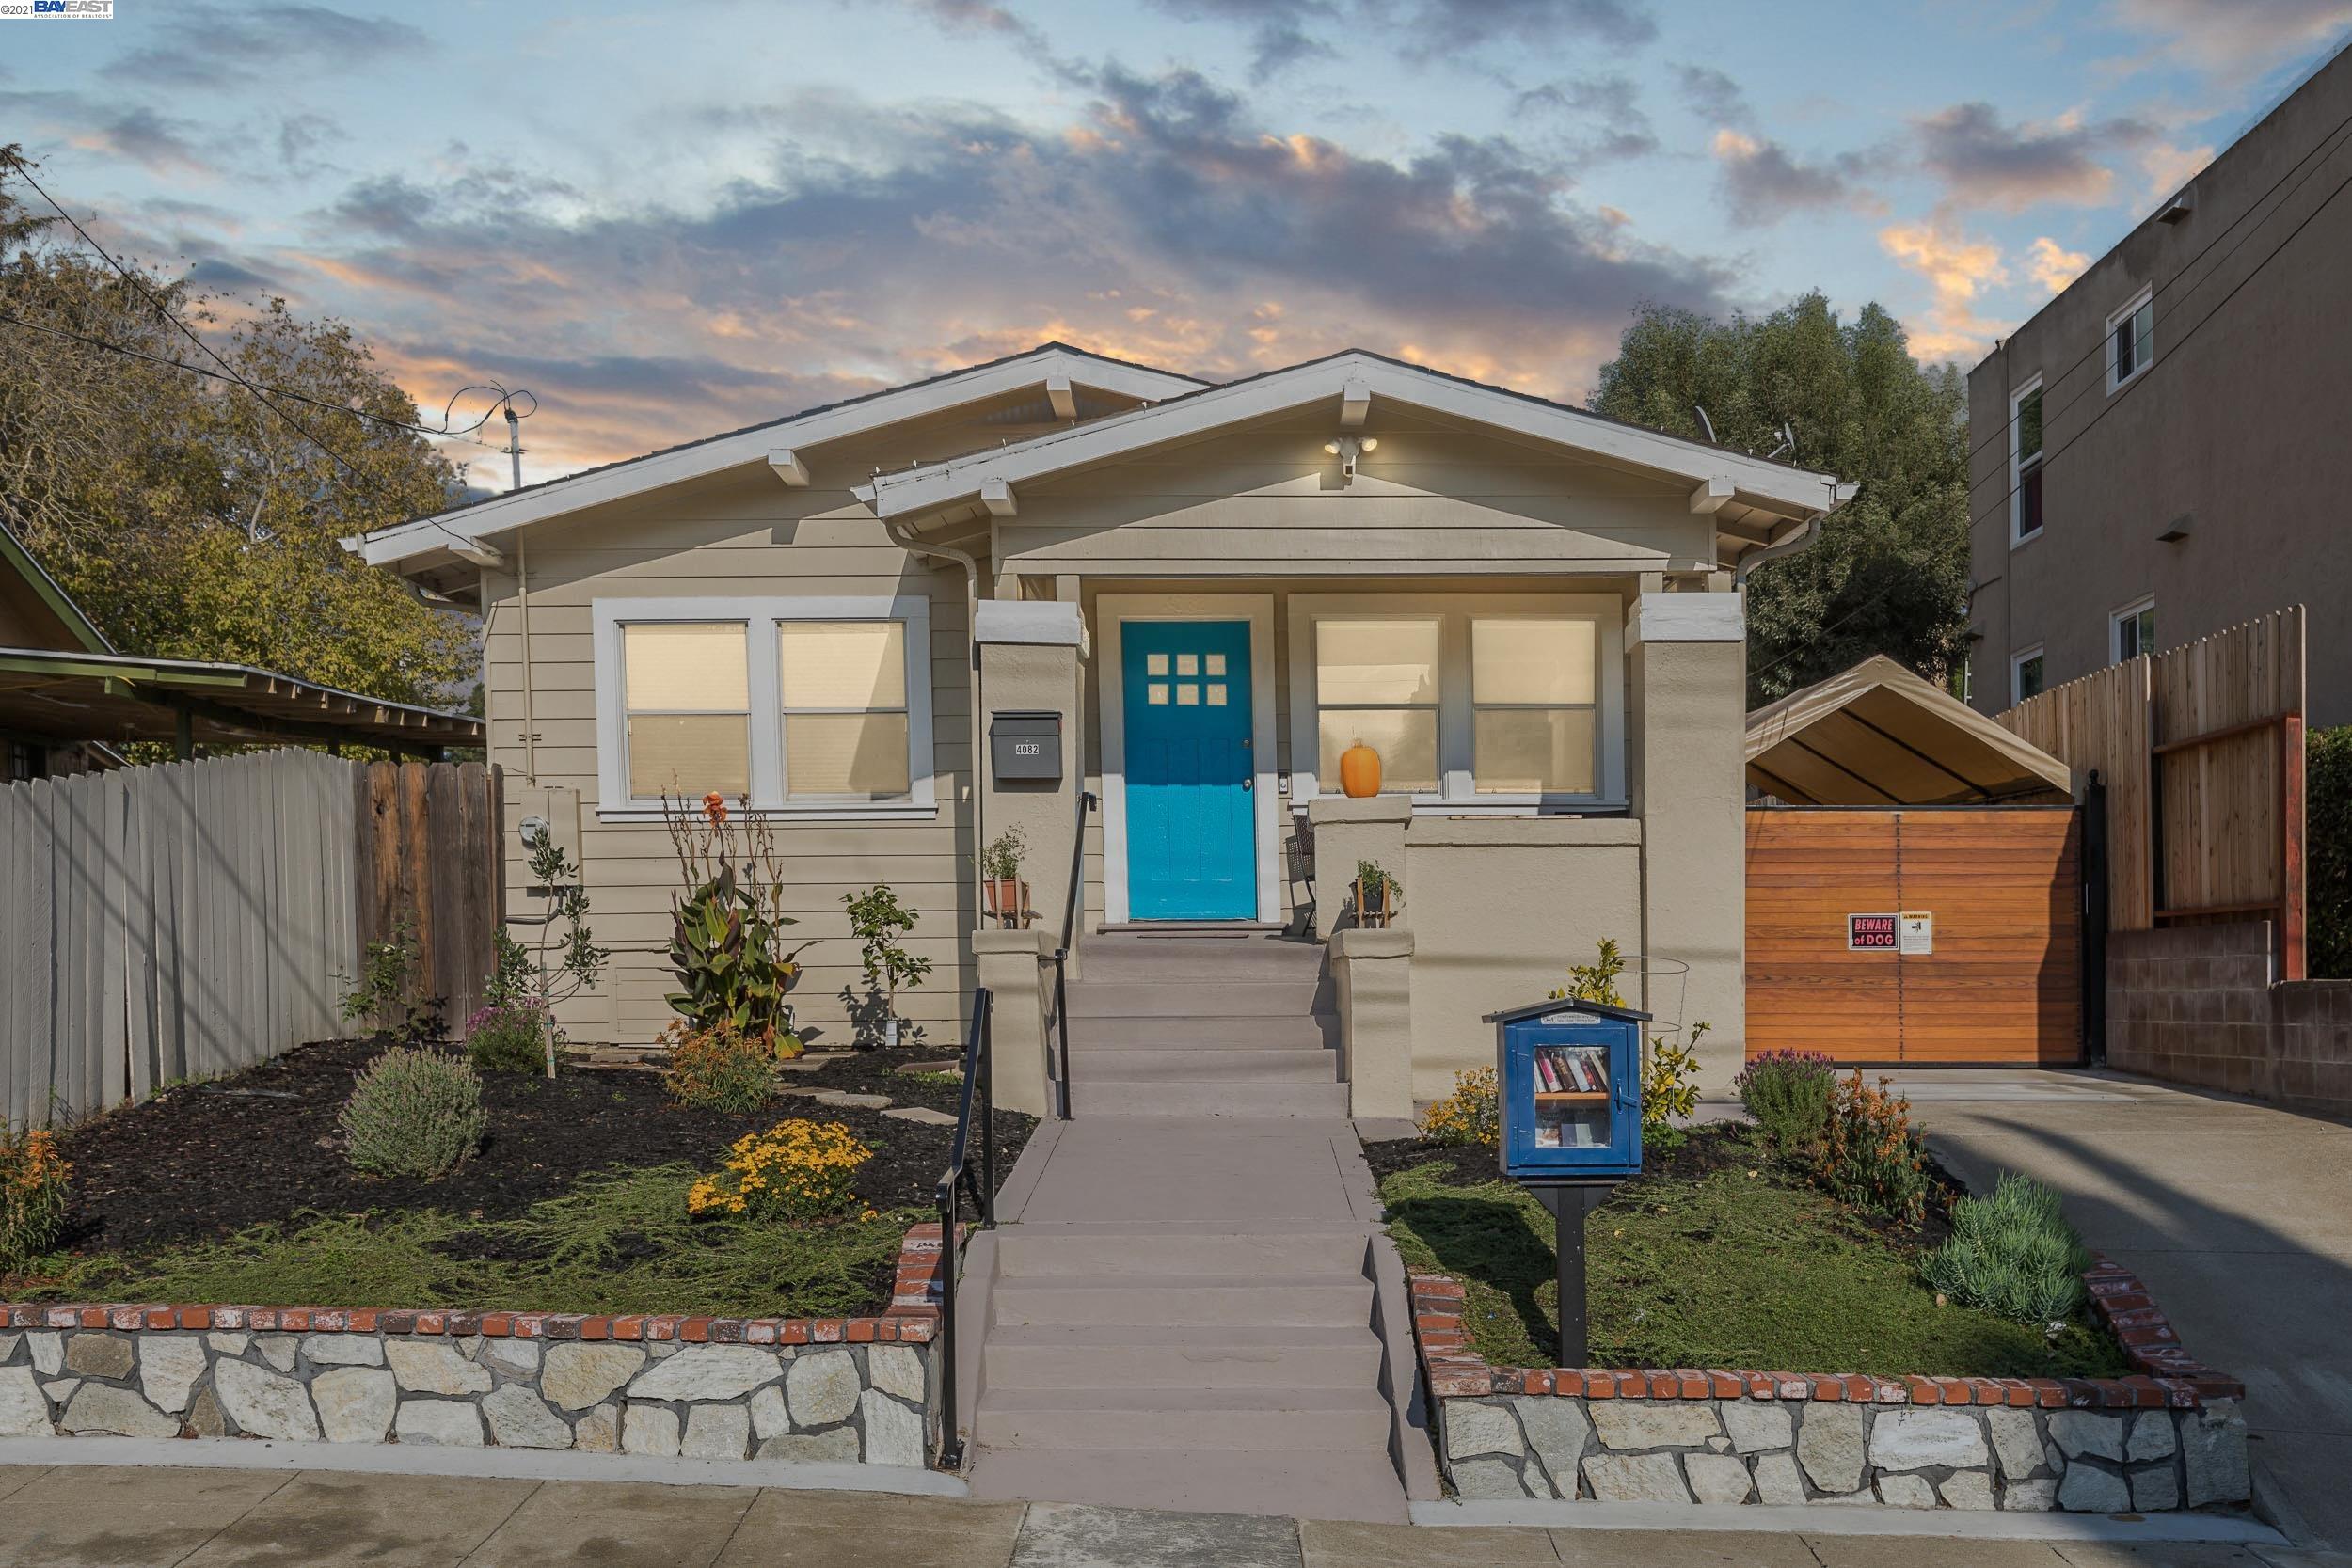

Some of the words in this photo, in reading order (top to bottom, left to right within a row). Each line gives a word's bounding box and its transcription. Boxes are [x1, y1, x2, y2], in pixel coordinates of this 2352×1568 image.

[1017, 745, 1038, 754] 4082
[1854, 919, 1893, 930] BEWARE
[1854, 934, 1865, 945] of
[1867, 934, 1894, 945] DOG
